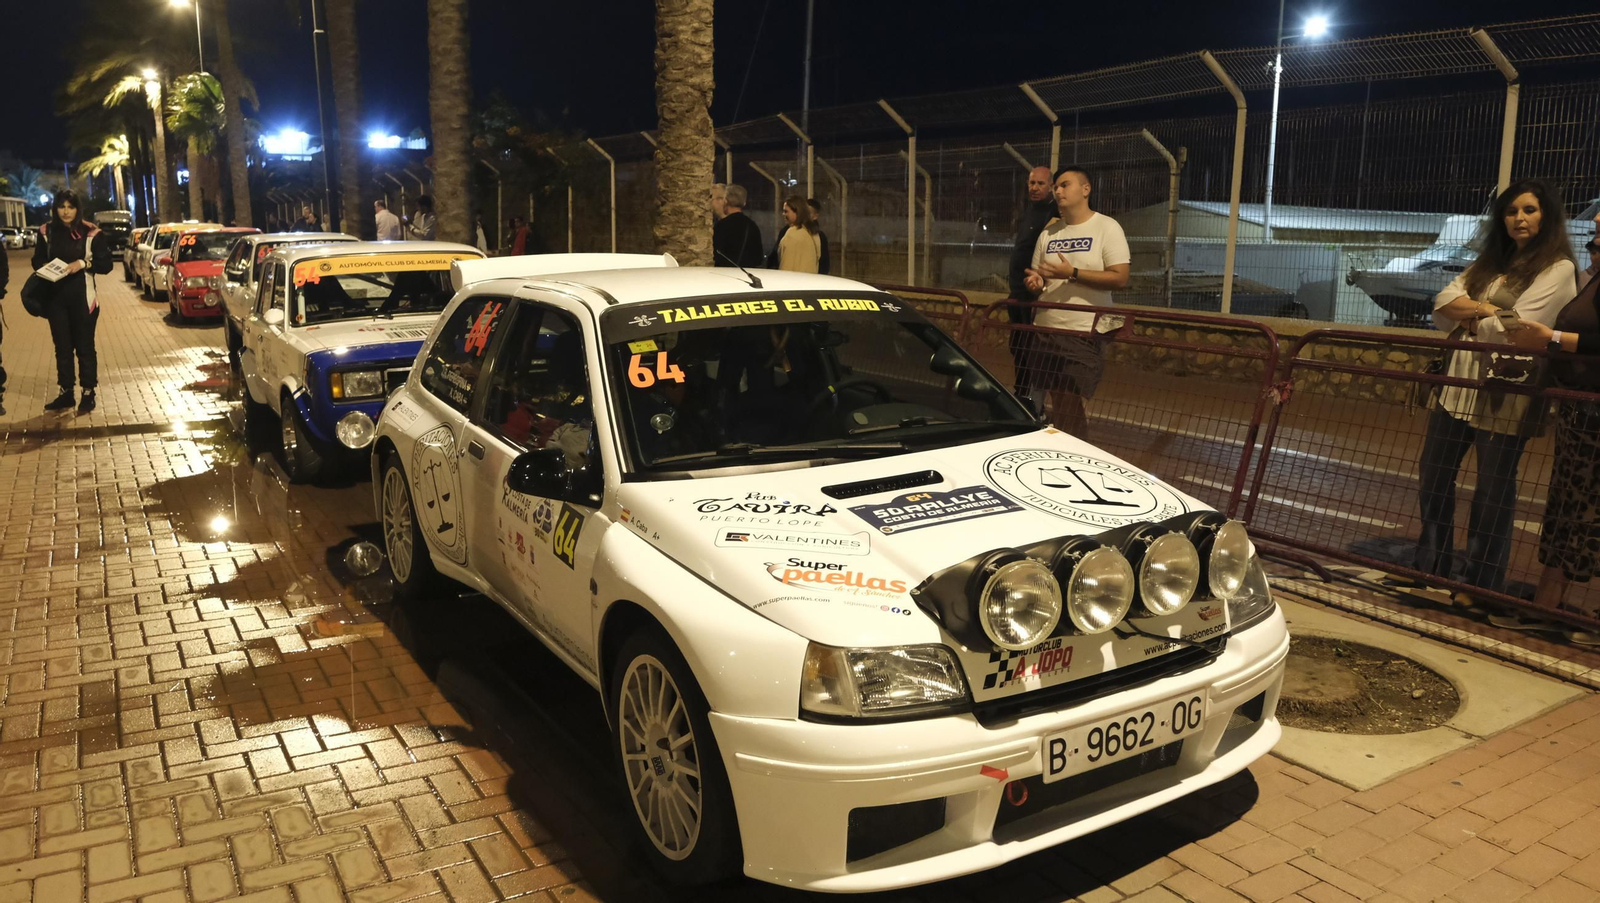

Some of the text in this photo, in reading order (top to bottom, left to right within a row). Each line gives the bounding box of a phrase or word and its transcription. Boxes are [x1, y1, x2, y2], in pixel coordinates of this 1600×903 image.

[180, 235, 197, 247] 66
[1049, 240, 1091, 250] sparco
[339, 260, 383, 269] AUTOMÓVIL
[294, 267, 321, 287] 54
[657, 298, 880, 324] TALLERES EL RUBIO
[628, 351, 686, 388] 64
[993, 451, 1155, 487] AC PERITACIONES
[692, 497, 838, 517] TAVIRA
[902, 491, 994, 514] RALLYE
[1022, 494, 1124, 526] JUDICIALES
[636, 519, 648, 533] Caba
[699, 515, 824, 527] PUERTO LOPE
[883, 512, 926, 524] COSTA
[926, 508, 946, 517] DE
[554, 510, 580, 566] 64
[752, 533, 861, 547] VALENTINES
[787, 558, 848, 571] Super
[782, 568, 907, 594] paellas
[753, 596, 831, 609] www.superpaellas.com
[1012, 645, 1074, 680] A JOPO
[1049, 737, 1067, 776] B
[1087, 711, 1155, 763] 9662
